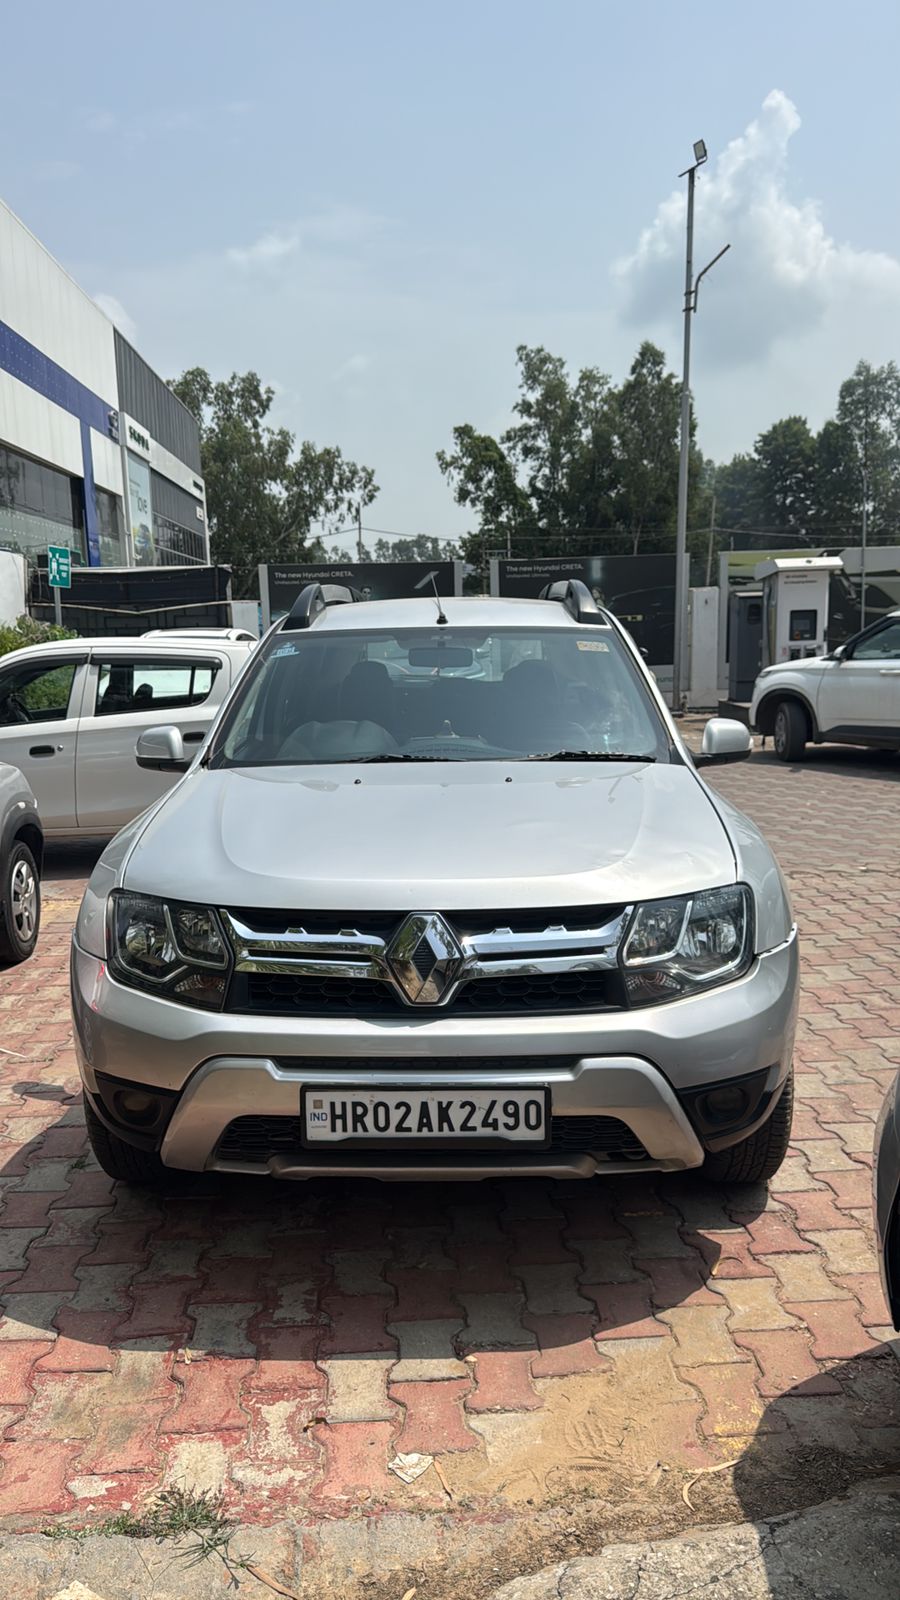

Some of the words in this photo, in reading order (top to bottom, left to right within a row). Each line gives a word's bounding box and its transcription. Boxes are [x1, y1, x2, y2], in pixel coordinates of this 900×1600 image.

[533, 564, 560, 573] Hyundai
[303, 571, 330, 579] Hyundai
[310, 1112, 328, 1121] IND
[329, 1099, 542, 1133] HR02AK2490
